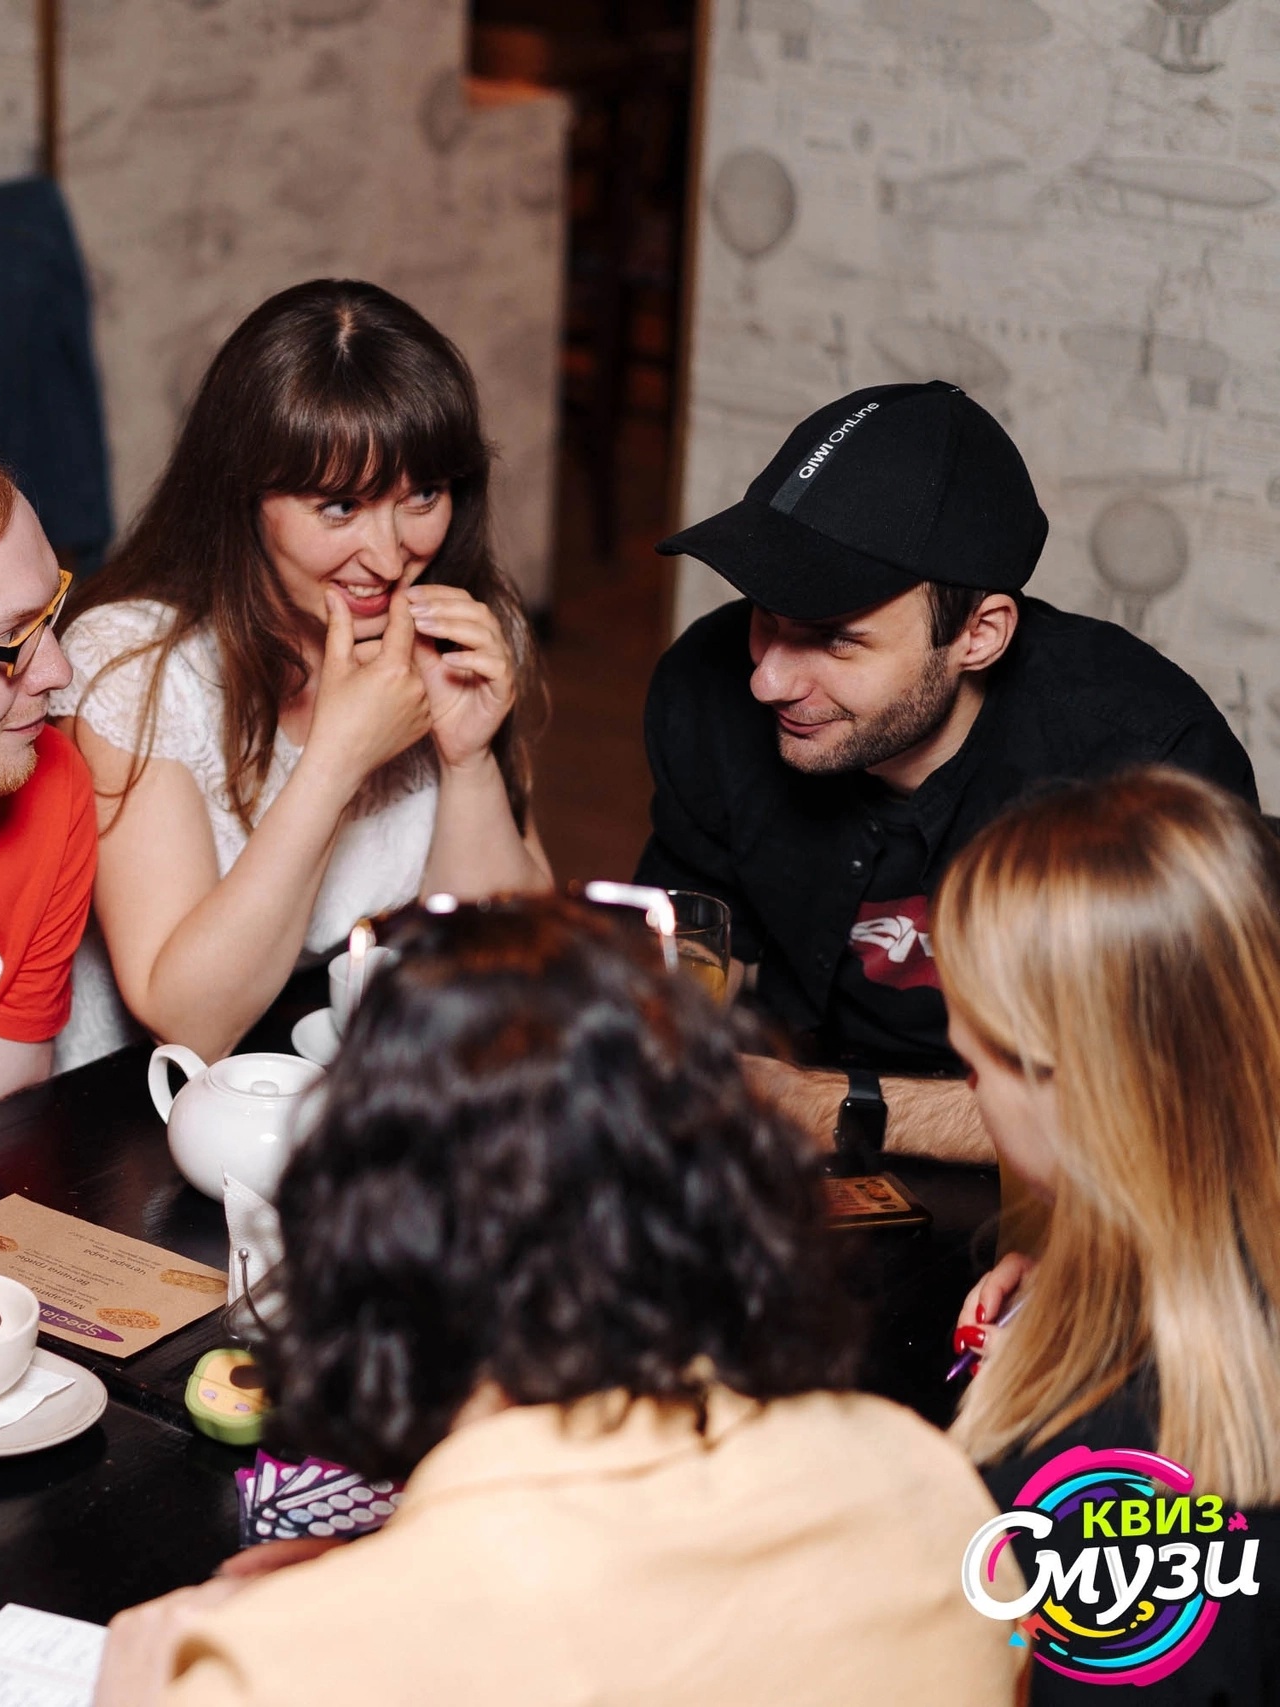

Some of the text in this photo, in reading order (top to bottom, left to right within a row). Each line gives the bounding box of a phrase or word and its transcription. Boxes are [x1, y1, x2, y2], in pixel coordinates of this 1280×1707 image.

[799, 402, 880, 479] QIWI OnLine
[47, 1266, 91, 1286] Ветчина
[31, 1286, 86, 1310] Маргарита
